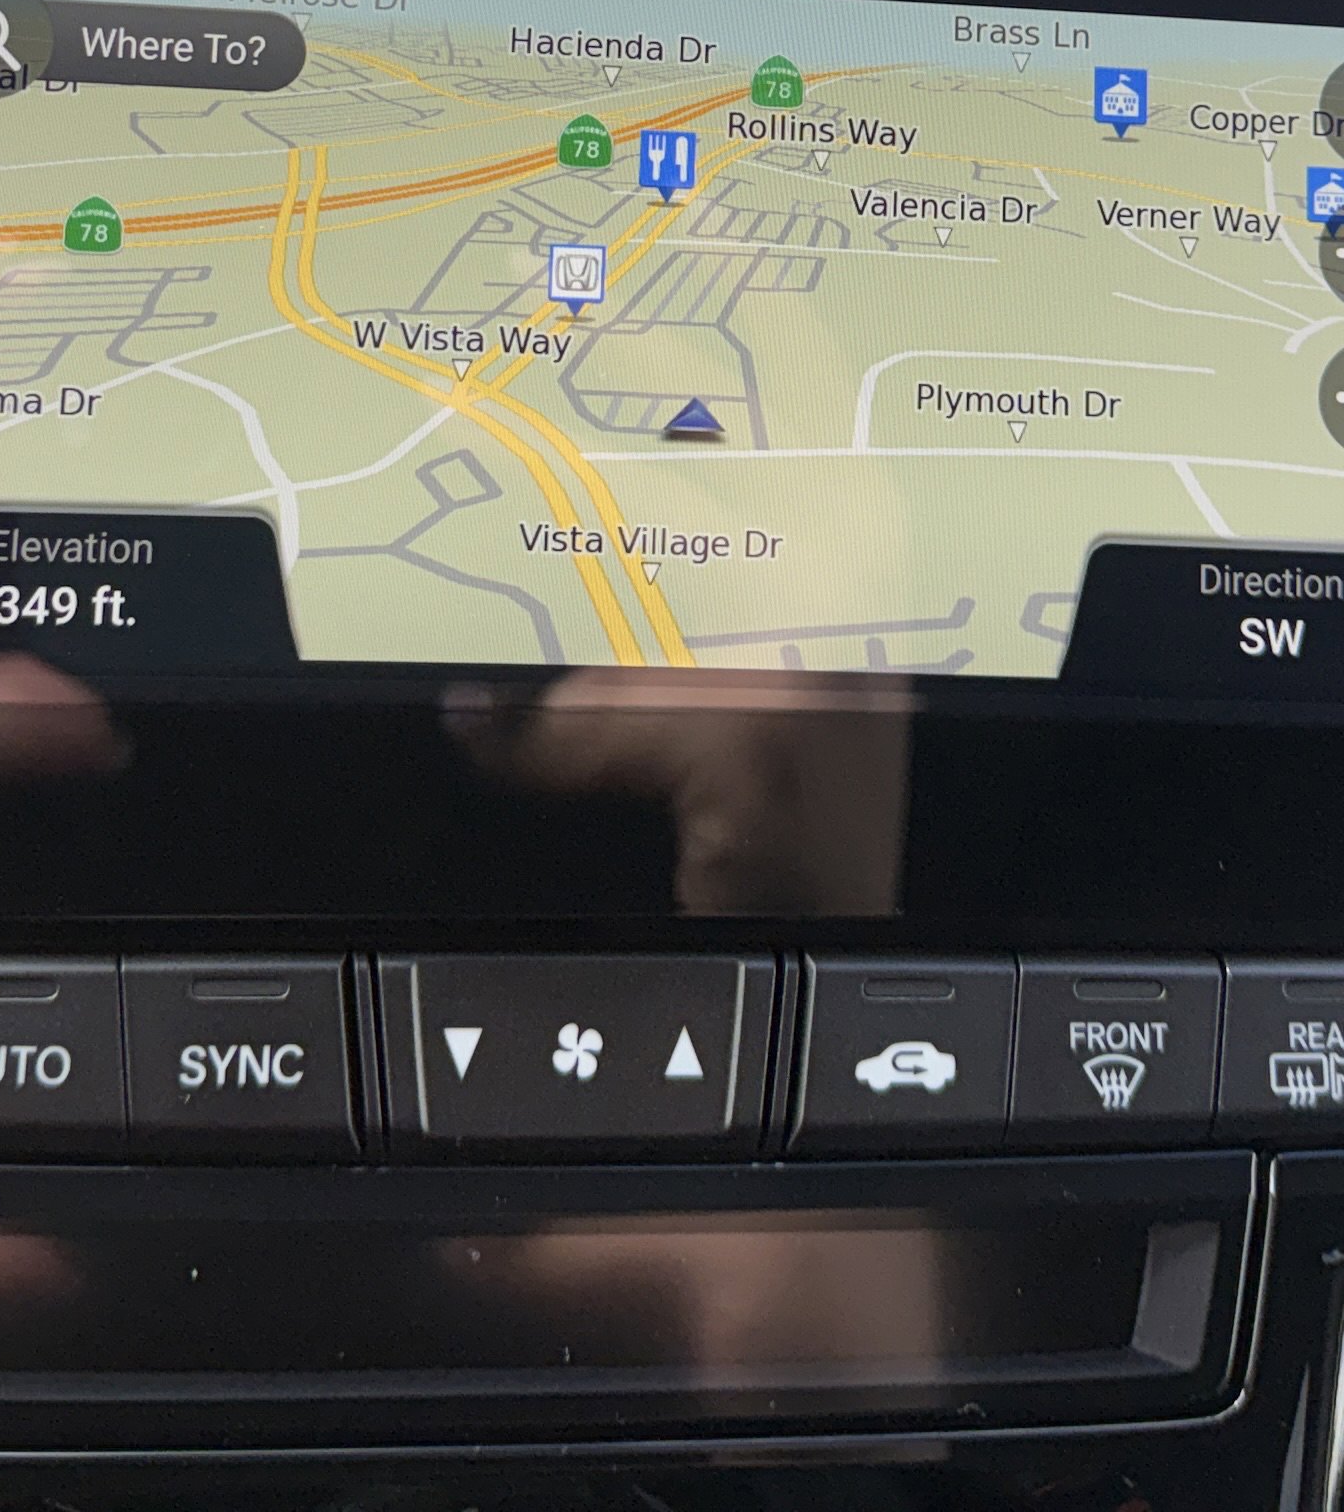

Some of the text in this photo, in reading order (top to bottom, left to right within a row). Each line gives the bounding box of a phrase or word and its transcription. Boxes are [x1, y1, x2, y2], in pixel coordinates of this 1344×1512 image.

[81, 26, 266, 68] Where To?
[510, 26, 717, 65] Hacienda Dr
[953, 17, 1090, 49] Brass Ln
[766, 80, 792, 99] 78
[728, 112, 918, 154] Rollins Way
[1190, 103, 1300, 139] Copper
[573, 140, 600, 159] 78
[850, 189, 1038, 225] Valencia Dr
[1097, 201, 1282, 239] Verner Way
[80, 223, 108, 243] 78
[355, 321, 572, 362] W Vista Way
[60, 388, 102, 416] Dr
[916, 384, 1121, 419] Plymouth Dr
[520, 525, 783, 563] Vista Village Dr
[1199, 565, 1344, 601] Direction
[90, 585, 136, 627] ft.
[1239, 618, 1304, 656] SW
[1069, 1019, 1167, 1051] FRONT
[178, 1042, 304, 1088] SYNC
